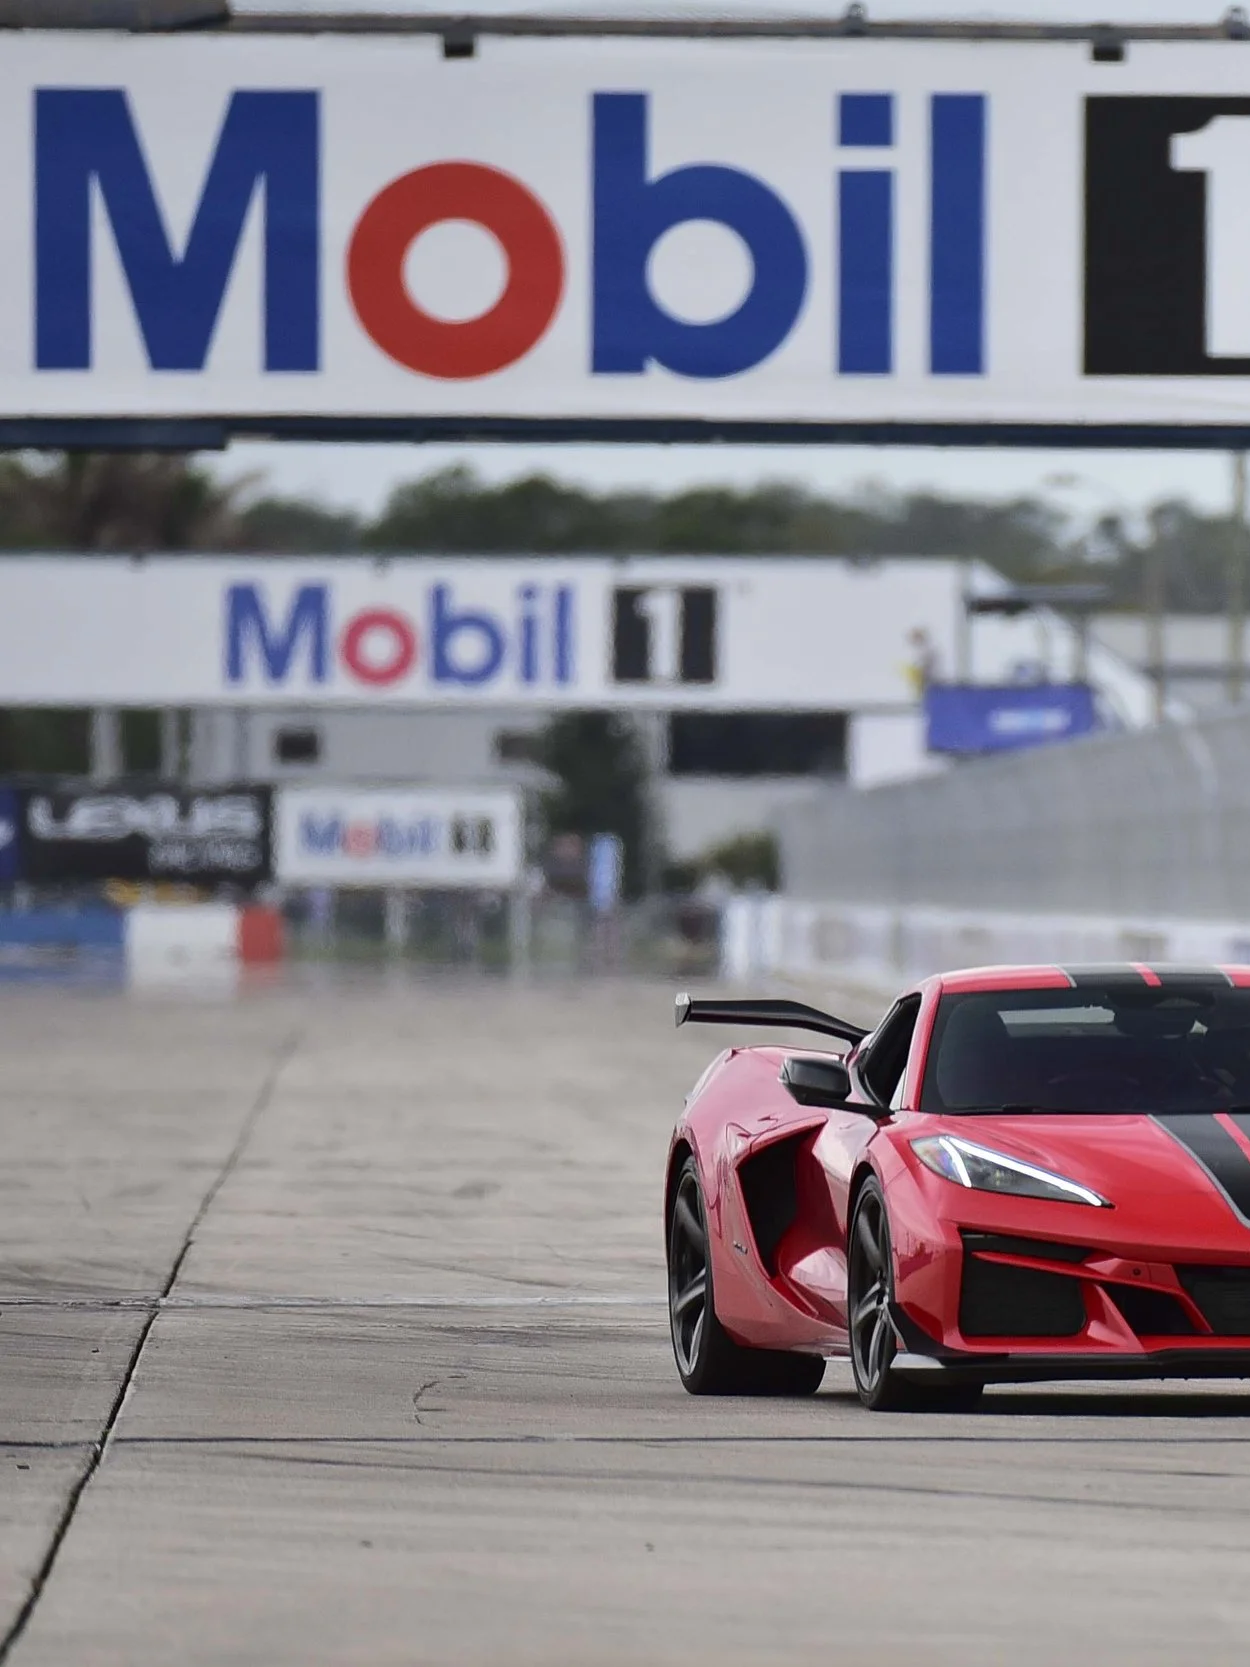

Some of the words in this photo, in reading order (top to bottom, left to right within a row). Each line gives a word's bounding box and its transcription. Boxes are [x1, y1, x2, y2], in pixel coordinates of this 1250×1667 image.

[33, 88, 988, 380] Mobil
[225, 582, 573, 685] Mobil
[634, 588, 682, 682] 1
